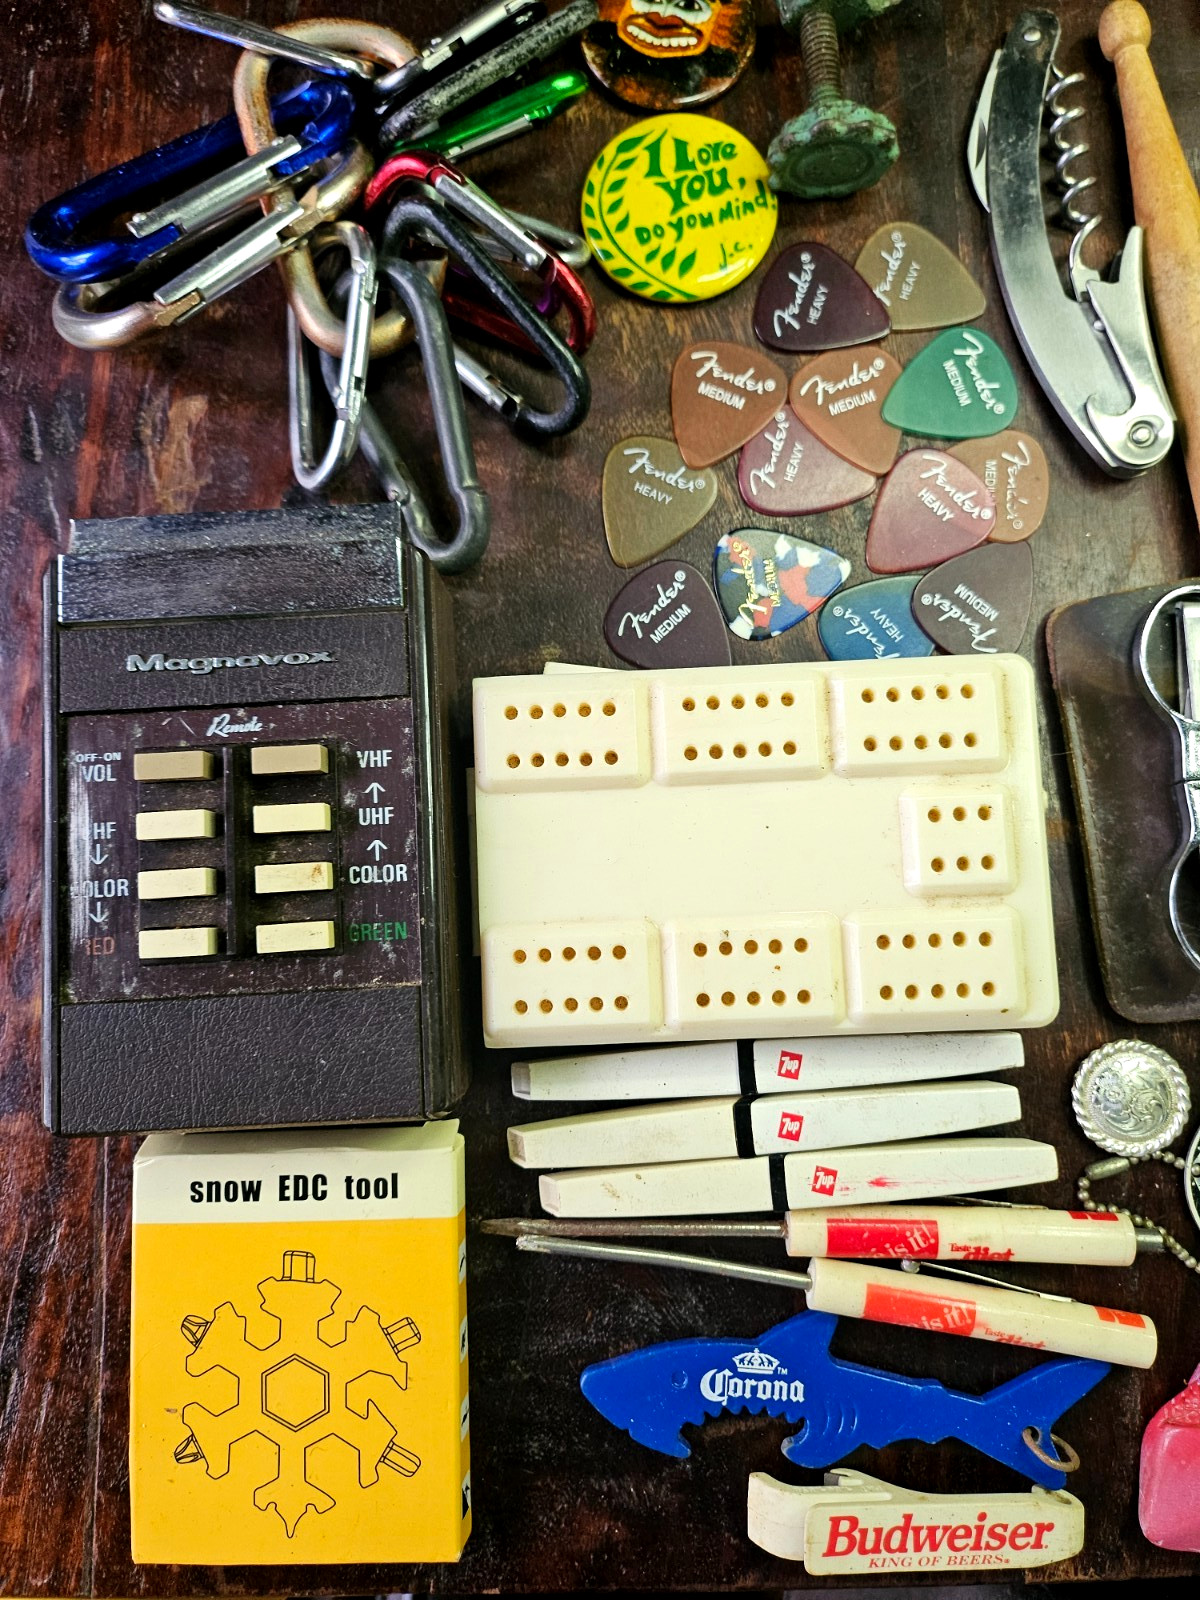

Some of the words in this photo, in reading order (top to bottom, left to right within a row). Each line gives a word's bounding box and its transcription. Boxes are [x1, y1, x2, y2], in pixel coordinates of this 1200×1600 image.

[643, 129, 668, 179] I
[899, 260, 921, 301] HEAVY
[806, 284, 829, 325] HEAVY
[698, 381, 746, 411] MEDIUM
[942, 359, 972, 408] MEDIUM
[828, 389, 877, 416] MEDIUM
[784, 442, 804, 483] HEAVY
[634, 482, 672, 505] HEAVY
[984, 459, 998, 501] MEDI
[917, 488, 956, 522] HEAVY
[953, 582, 1000, 621] MEDIUM
[649, 603, 692, 644] MEDIUM
[870, 608, 904, 643] HEAVY
[126, 650, 333, 675] Magnavox
[206, 713, 264, 738] Remote
[75, 752, 122, 763] OFF-ON
[357, 750, 393, 769] VHF
[82, 764, 117, 782] VOL
[359, 806, 394, 826] UHF
[88, 822, 116, 840] HF
[349, 864, 408, 884] COLOR
[349, 921, 408, 943] GREEN
[190, 1179, 262, 1203] snow
[278, 1173, 328, 1202] EDC
[345, 1173, 399, 1200] tool
[950, 1243, 971, 1252] Taste
[984, 1327, 1005, 1338] Taste
[700, 1368, 805, 1406] Corona
[822, 1511, 1055, 1558] Budweiser
[868, 1556, 912, 1568] KING
[918, 1556, 942, 1567] OF
